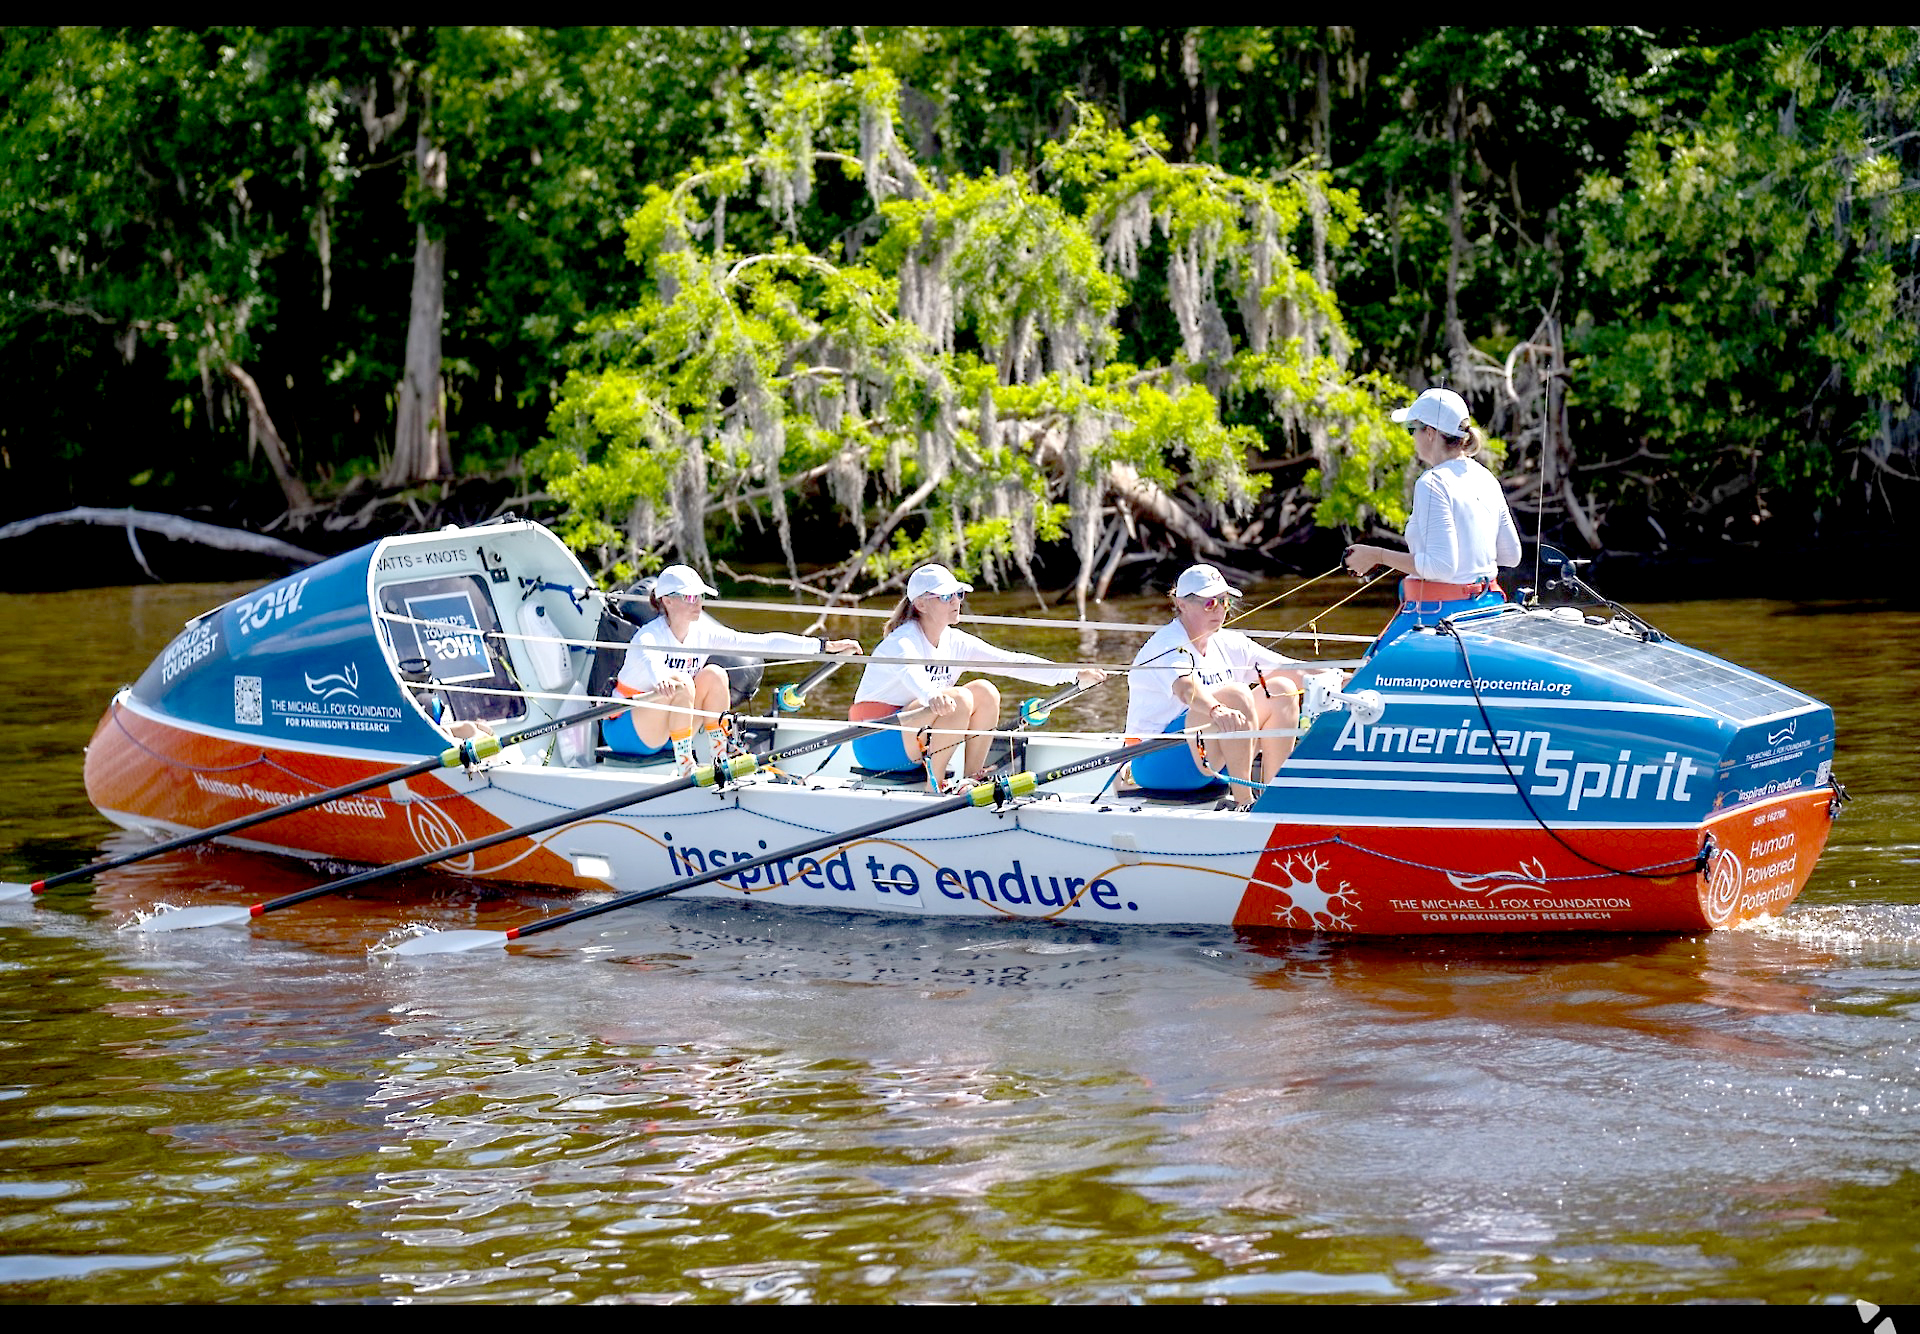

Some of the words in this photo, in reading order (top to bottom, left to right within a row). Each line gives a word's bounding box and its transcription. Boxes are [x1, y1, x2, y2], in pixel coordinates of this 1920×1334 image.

[425, 549, 467, 565] KNOTS
[163, 621, 212, 666] WORLD'S
[162, 632, 219, 685] TOUGHEST
[1374, 674, 1573, 696] humanpoweredpotential.org
[271, 699, 286, 712] THE
[287, 701, 321, 714] MICHAEL
[322, 703, 329, 714] J.
[331, 703, 347, 715] FOX
[348, 705, 402, 719] FOUNDATION
[285, 717, 300, 727] FOR
[301, 718, 349, 730] PARKINSON'S
[350, 720, 390, 733] RESEARCH
[1333, 713, 1551, 757] American
[782, 741, 820, 758] concept
[822, 739, 828, 747] 2
[1062, 758, 1102, 776] concept
[1104, 756, 1110, 764] 2
[193, 771, 246, 800] Human
[242, 783, 305, 807] Powered
[1530, 749, 1698, 811] Spirit
[1738, 786, 1768, 801] inspired
[1768, 782, 1776, 793] to
[1750, 833, 1795, 859] Human
[663, 831, 856, 895] inspired
[866, 855, 920, 896] to
[935, 860, 1139, 911] endure.
[1745, 852, 1797, 886] Powered
[1390, 899, 1418, 910] THE
[1421, 899, 1482, 910] MICHAEL
[1488, 900, 1499, 910] J.
[1501, 899, 1529, 909] FOX
[1533, 897, 1632, 909] FOUNDATION
[1740, 878, 1795, 912] Potential
[1422, 913, 1448, 921] FOR
[1451, 912, 1539, 921] PARKINSON'S
[1542, 912, 1612, 920] RESEARCH
